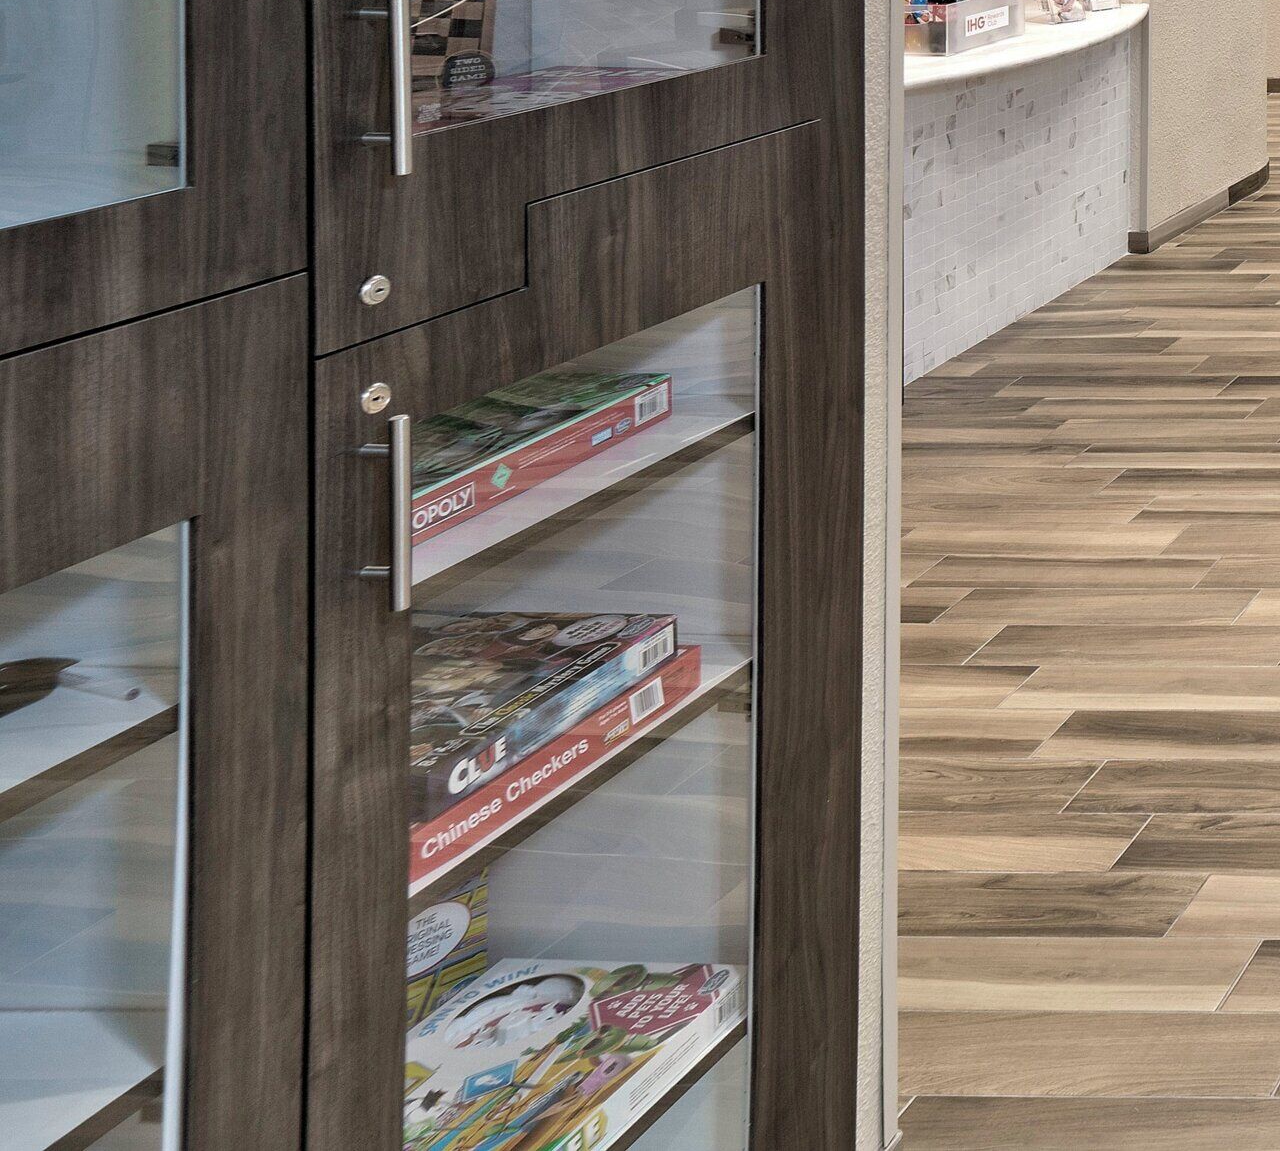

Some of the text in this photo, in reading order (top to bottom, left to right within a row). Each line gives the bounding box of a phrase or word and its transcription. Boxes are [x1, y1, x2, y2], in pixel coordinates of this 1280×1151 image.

[967, 16, 985, 33] IHG
[450, 64, 486, 74] SIDED
[454, 57, 482, 66] TWO
[449, 73, 487, 82] GAME
[411, 487, 471, 530] OPOLY
[448, 736, 507, 795] CLUE
[420, 797, 503, 859] Chinese
[505, 738, 590, 802] Checkers
[416, 912, 439, 929] THE
[452, 990, 480, 1005] TO
[484, 963, 543, 989] WIN!
[616, 994, 647, 1018] ADD
[627, 993, 663, 1019] PETS
[649, 983, 690, 1013] YOUR
